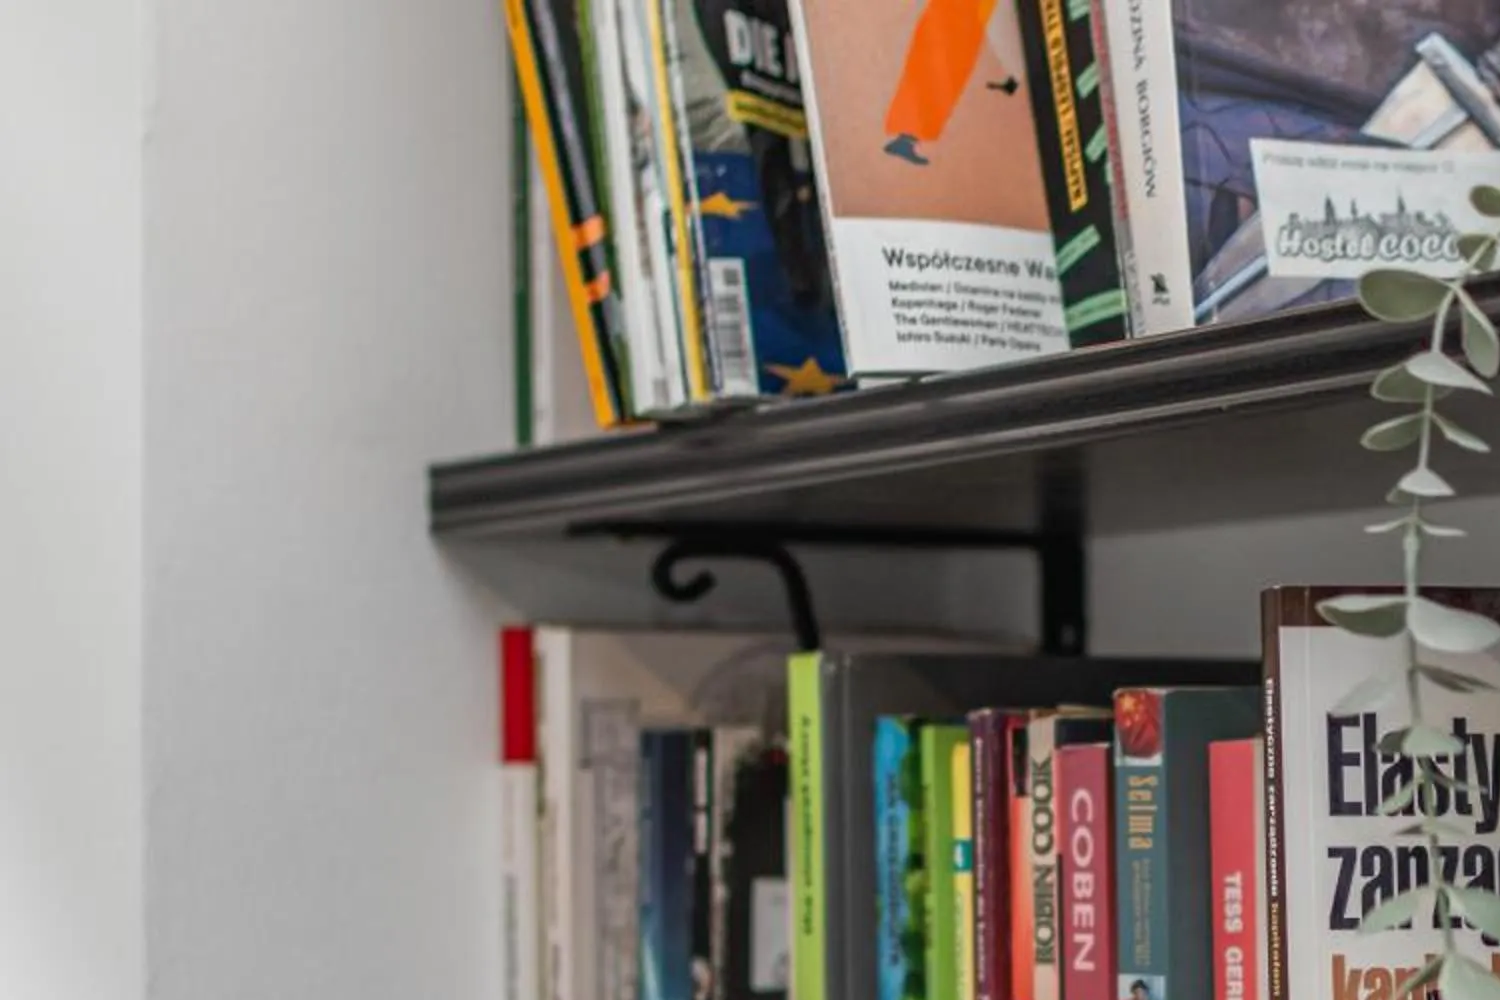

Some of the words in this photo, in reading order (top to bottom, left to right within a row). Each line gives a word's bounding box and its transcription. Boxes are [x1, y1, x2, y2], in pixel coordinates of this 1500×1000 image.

[723, 8, 783, 78] DIE
[1135, 78, 1160, 200] BORGIÓW
[882, 247, 1020, 276] Współczesne
[1277, 223, 1376, 262] Hostel
[1034, 756, 1054, 855] COOK
[1128, 774, 1158, 850] Selma
[1035, 863, 1056, 965] ROBIN
[1072, 789, 1095, 971] COBEN
[1223, 870, 1243, 933] TESS
